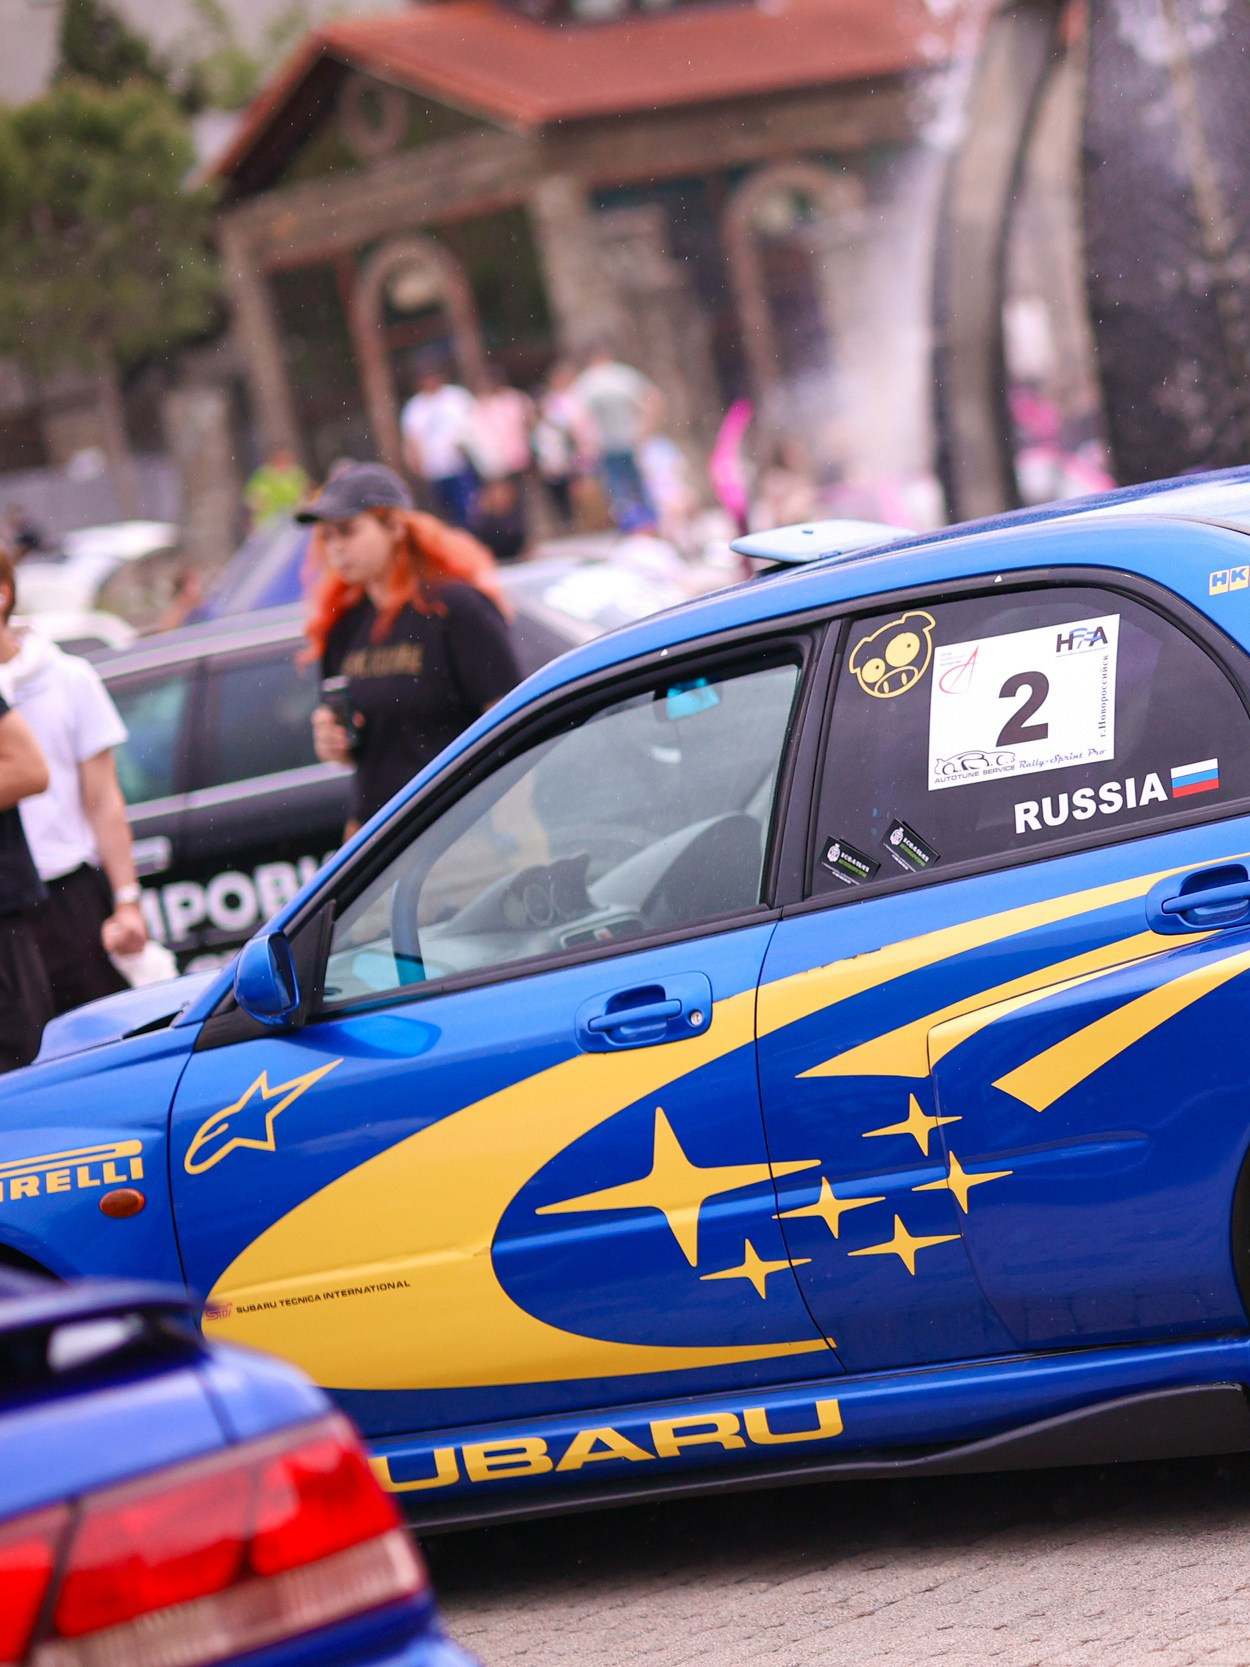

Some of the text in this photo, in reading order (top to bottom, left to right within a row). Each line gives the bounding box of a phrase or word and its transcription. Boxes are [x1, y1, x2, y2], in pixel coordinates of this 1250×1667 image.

[995, 671, 1050, 747] 2
[934, 764, 1016, 784] AUTOTUNE SERVICE
[1019, 748, 1107, 769] Rally-Sprint Pro
[1014, 772, 1168, 834] RUSSIA
[236, 1303, 277, 1314] SUBARU
[278, 1294, 322, 1308] TECNICA
[322, 1280, 411, 1300] INTERNATIONAL
[369, 1398, 844, 1493] UBARU
